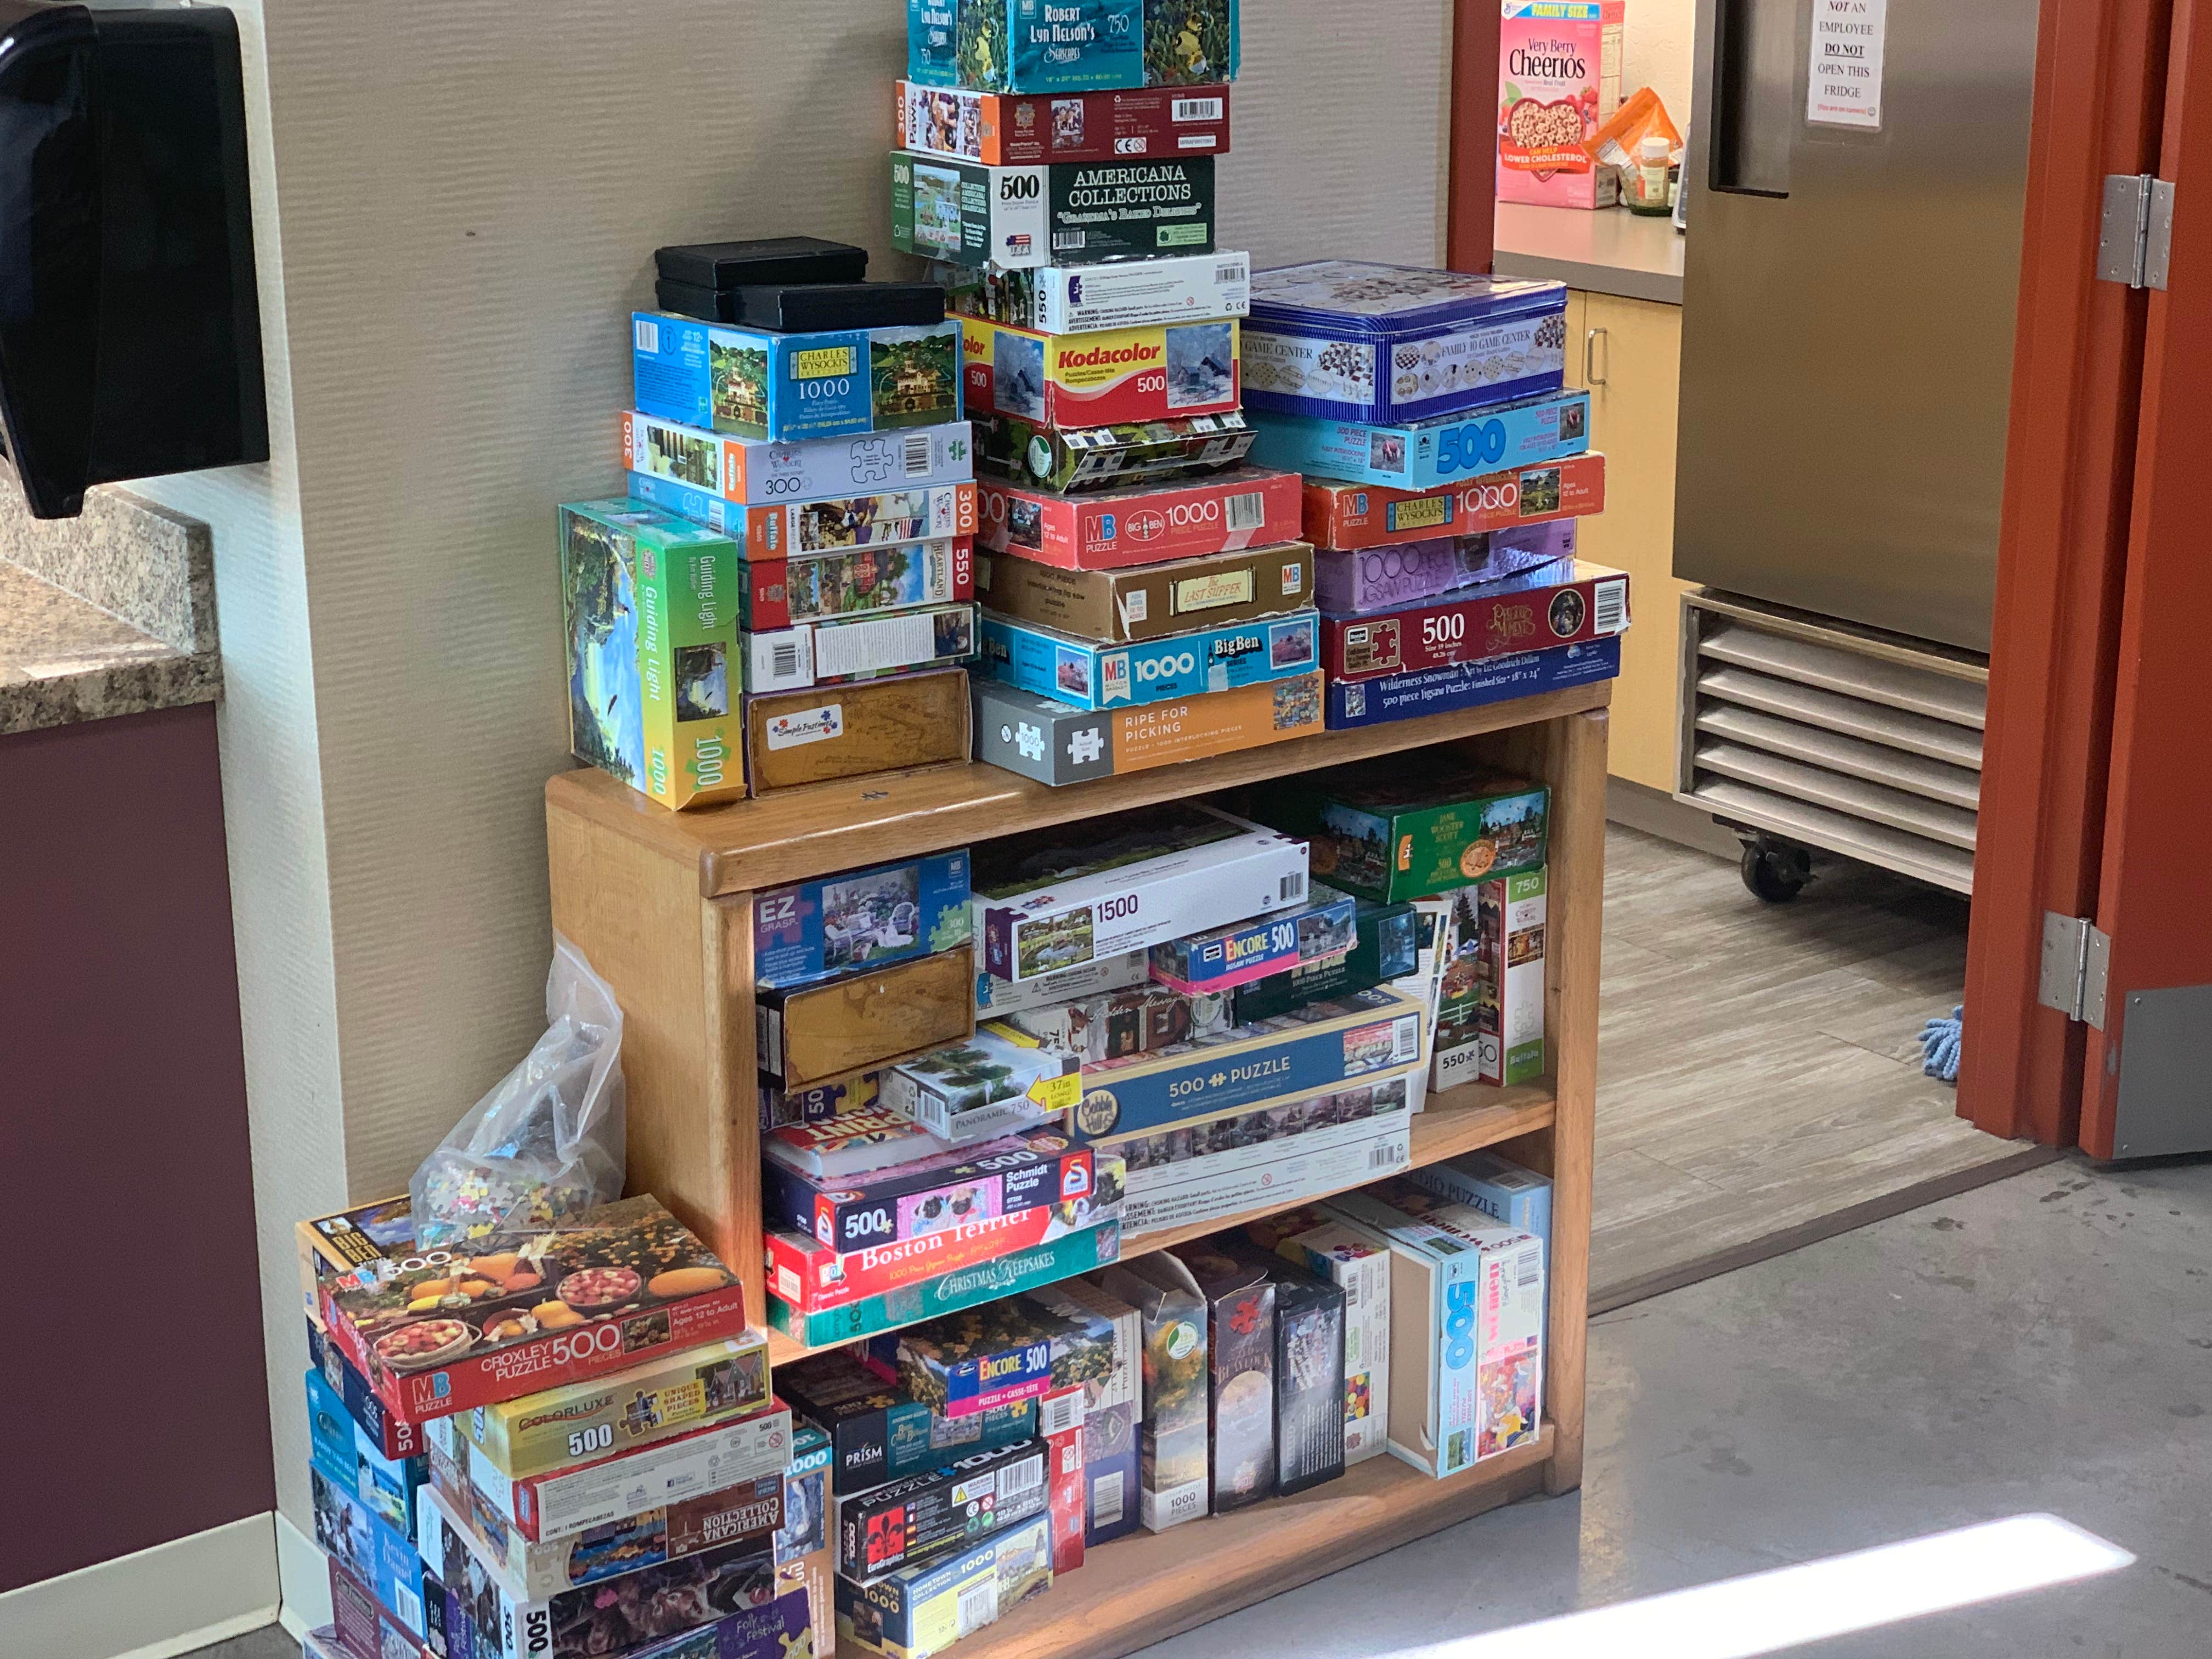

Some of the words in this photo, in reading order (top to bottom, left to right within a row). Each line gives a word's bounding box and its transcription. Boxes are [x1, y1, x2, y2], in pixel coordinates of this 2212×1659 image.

[1531, 4, 1566, 18] FAMILY
[1568, 4, 1588, 18] SIZE
[1827, 1, 1850, 12] NOT
[1852, 3, 1866, 13] AN
[1107, 14, 1129, 34] 750
[1819, 21, 1874, 35] EMPLOYEE
[1528, 38, 1549, 55] Very
[1551, 40, 1577, 57] Berry
[1825, 43, 1839, 54] DO
[1843, 44, 1865, 55] NOT
[1510, 49, 1585, 78] Cheerios
[1818, 63, 1844, 75] OPEN
[1847, 66, 1870, 78] THIS
[1824, 84, 1861, 98] FRIDGE
[1504, 154, 1530, 163] LOWER
[1531, 154, 1587, 163] CHOLESTEROL
[1542, 146, 1557, 154] HELP
[1000, 174, 1040, 200] 500
[1073, 165, 1187, 188] AMERICANA
[1069, 184, 1191, 207] COLLECTIONS
[1245, 342, 1273, 355] GAME
[1275, 345, 1313, 360] CENTER
[1442, 342, 1469, 358] FAMILY
[1479, 335, 1500, 351] GAME
[1502, 329, 1531, 347] CENTER
[800, 349, 848, 362] CHARLES
[800, 358, 848, 370] WYSOCKI'S
[1058, 343, 1161, 369] Kodacolor
[799, 379, 850, 399] 1000
[971, 370, 987, 388] 500
[1137, 375, 1165, 393] 500
[624, 421, 633, 459] 300
[1344, 436, 1367, 447] PUZZLE
[1436, 418, 1506, 475] 500
[765, 477, 802, 495] 300
[959, 490, 973, 528] 300
[1342, 493, 1368, 518] MB
[1397, 499, 1443, 512] CHARLES
[1455, 483, 1517, 514] 1000
[1166, 500, 1219, 527] 1000
[1342, 516, 1369, 527] PUZZLE
[1397, 507, 1443, 522] WYSOCKI'S
[769, 512, 778, 551] Buffalo
[1043, 522, 1056, 532] Ages
[1085, 514, 1118, 544] MB
[1127, 522, 1141, 532] BIG
[1149, 520, 1164, 530] BEN
[1086, 542, 1118, 554] PUZZLE
[933, 542, 944, 597] HEARTLAND
[956, 548, 970, 585] 550
[1283, 566, 1301, 584] MB
[1359, 545, 1420, 585] 1000
[697, 555, 716, 608] Guiding
[1184, 590, 1205, 603] LAST
[1206, 580, 1243, 599] SUPPER
[644, 586, 658, 655] Guiding
[698, 610, 716, 631] Light
[1422, 613, 1465, 645] 500
[1444, 641, 1463, 650] inches
[1104, 659, 1127, 682] MB
[1134, 652, 1194, 682] 1000
[1379, 673, 1423, 692] Wilderness
[1423, 668, 1459, 685] Snowman
[1493, 658, 1520, 672] Goodrich
[645, 658, 662, 702] Light
[1155, 682, 1178, 693] PIECES
[1383, 696, 1398, 709] 500
[1399, 691, 1419, 707] piece
[1420, 686, 1444, 702] Jigsaw
[1445, 681, 1471, 696] Puzzle:
[1472, 678, 1496, 690] Finished
[1496, 676, 1508, 685] Size
[1125, 713, 1156, 727] RIPE
[1161, 706, 1188, 721] FOR
[778, 724, 802, 737] Simple
[803, 719, 833, 732] Pastimes
[1126, 720, 1181, 742] PICKING
[1221, 724, 1243, 734] PIECES
[1021, 732, 1040, 747] 1000
[651, 746, 666, 797] 1000
[696, 736, 723, 787] 1000
[1516, 877, 1538, 894] 750
[760, 895, 795, 924] EZ
[1097, 894, 1138, 923] 1500
[761, 918, 796, 934] GRASP
[947, 917, 964, 929] 300
[1225, 932, 1268, 962] ENCORE
[1272, 922, 1295, 953] 500
[1443, 1052, 1465, 1070] 550
[1049, 1079, 1071, 1092] 37in
[1169, 1077, 1205, 1099] 500
[1231, 1056, 1290, 1083] PUZZLE
[955, 1109, 1008, 1130] PANORAMIC
[1008, 1099, 1029, 1115] 750
[1082, 1096, 1113, 1117] Cobble
[806, 1112, 911, 1141] PRINT
[1086, 1115, 1102, 1133] Hill
[977, 1152, 1038, 1170] 500
[1006, 1164, 1048, 1182] Schmidt
[1006, 1178, 1039, 1193] Puzzle
[1449, 1186, 1499, 1219] PUZZLE
[845, 1209, 887, 1239] 500
[331, 1232, 368, 1251] BIG
[861, 1233, 944, 1272] Boston
[345, 1244, 383, 1264] BEN
[386, 1251, 452, 1277] 500
[336, 1270, 376, 1289] MB
[934, 1268, 997, 1301] CHRISTMAS
[998, 1251, 1056, 1280] KEEPSAKES
[673, 1317, 693, 1327] Ages
[695, 1312, 705, 1322] 12
[706, 1310, 714, 1318] to
[716, 1302, 739, 1314] Adult
[1446, 1281, 1475, 1370] 500
[481, 1342, 549, 1373] CROXLEY
[552, 1323, 620, 1367] 500
[496, 1355, 552, 1383] PUZZLE
[588, 1348, 622, 1367] PIECES
[979, 1354, 1023, 1381] ENCORE
[1025, 1345, 1047, 1373] 500
[412, 1372, 452, 1404] MB
[663, 1390, 701, 1405] SHAPED
[664, 1381, 699, 1397] UNIQUE
[978, 1393, 1001, 1407] PUZZLE
[1007, 1383, 1039, 1399] CASSE-TÊTE
[415, 1398, 453, 1414] PUZZLE
[518, 1393, 614, 1431] COLORLUXE
[667, 1397, 700, 1412] PIECES
[760, 1421, 772, 1431] 500
[985, 1412, 1008, 1423] PIECES
[568, 1423, 613, 1457] 500
[783, 1451, 827, 1478] 1000
[846, 1446, 883, 1467] PRISM
[1170, 1491, 1197, 1508] 1000
[1171, 1503, 1197, 1516] PIECES
[702, 1498, 779, 1531] COLLECTION
[703, 1510, 779, 1541] AMERICANA
[867, 1552, 905, 1573] EuroGraphics
[961, 1550, 994, 1575] 1000
[912, 1579, 952, 1601] COLLECTION
[864, 1590, 900, 1614] 1000
[504, 1606, 514, 1651] 500
[527, 1610, 548, 1652] 500
[736, 1612, 757, 1633] Folk
[747, 1614, 785, 1644] Festival
